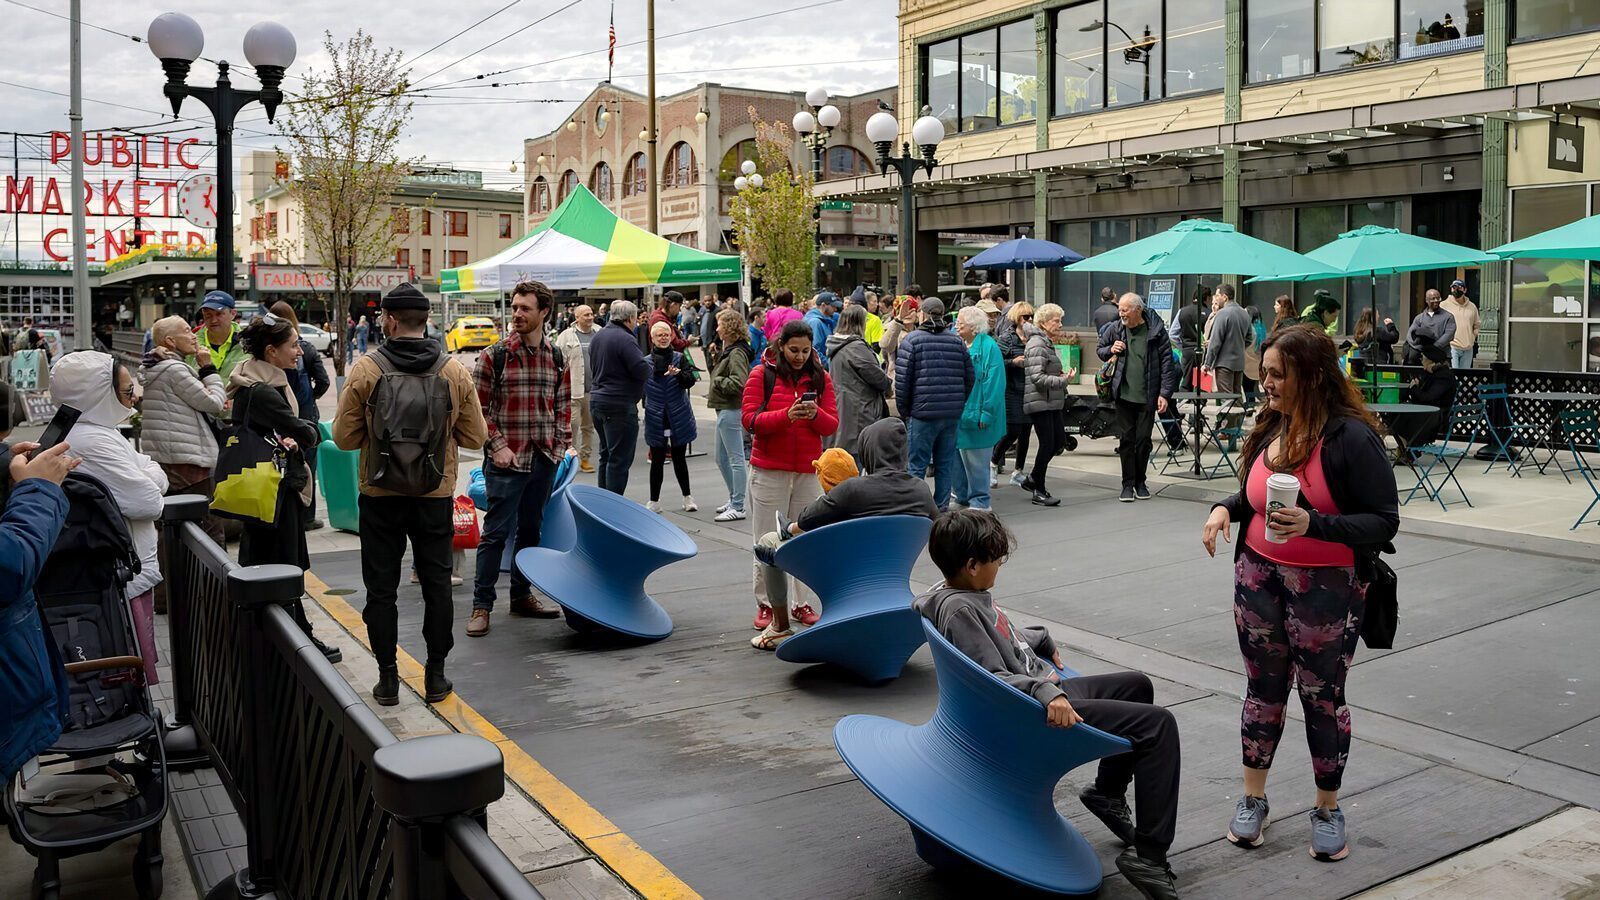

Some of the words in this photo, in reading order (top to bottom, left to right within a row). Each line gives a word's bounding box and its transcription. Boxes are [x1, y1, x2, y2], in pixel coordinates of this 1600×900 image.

[51, 131, 199, 170] PUBLIC
[6, 175, 178, 218] MARKET
[343, 274, 404, 288] ARKET
